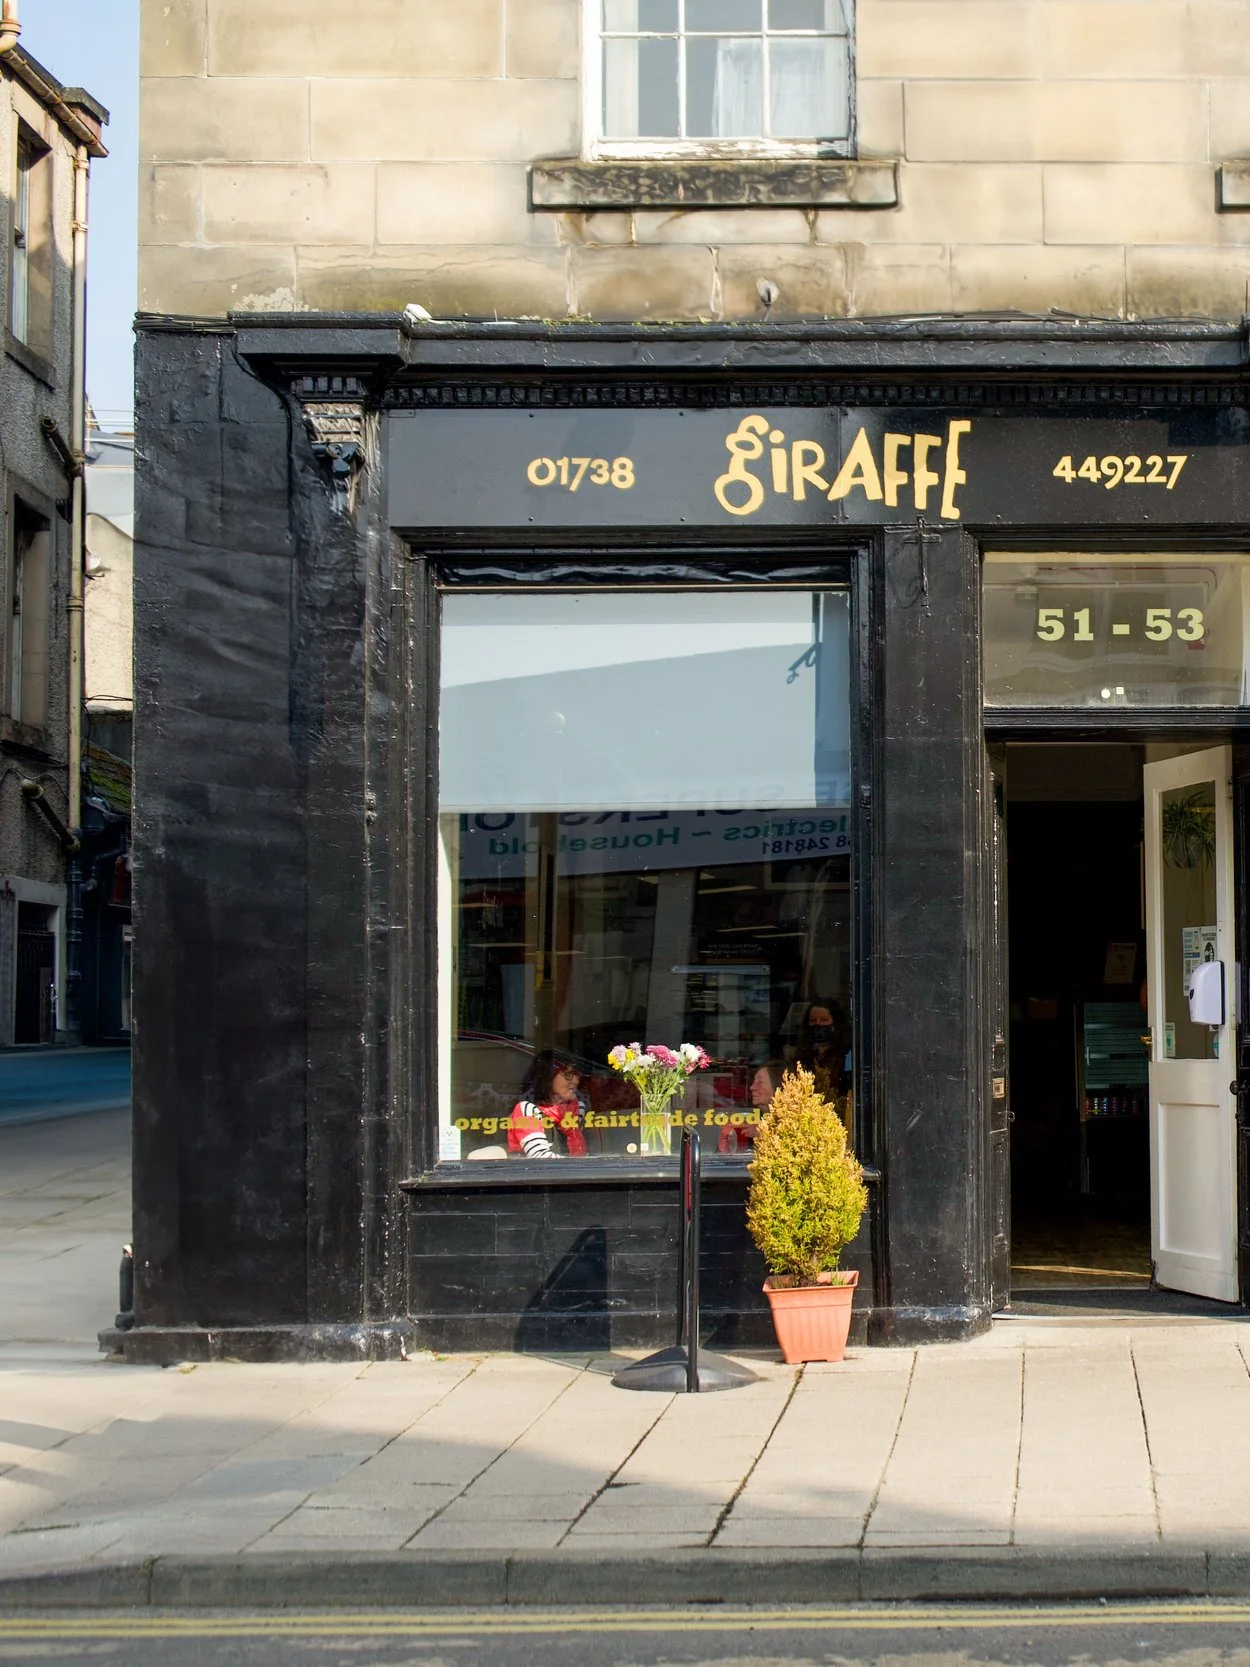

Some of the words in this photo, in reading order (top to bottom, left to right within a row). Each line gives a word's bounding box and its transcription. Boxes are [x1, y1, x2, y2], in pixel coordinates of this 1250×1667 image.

[526, 455, 636, 492] 01738
[1053, 454, 1187, 490] 449227
[1036, 607, 1095, 641] 51
[1144, 606, 1206, 642] 53
[455, 1110, 555, 1135] organic
[561, 1110, 580, 1130] &
